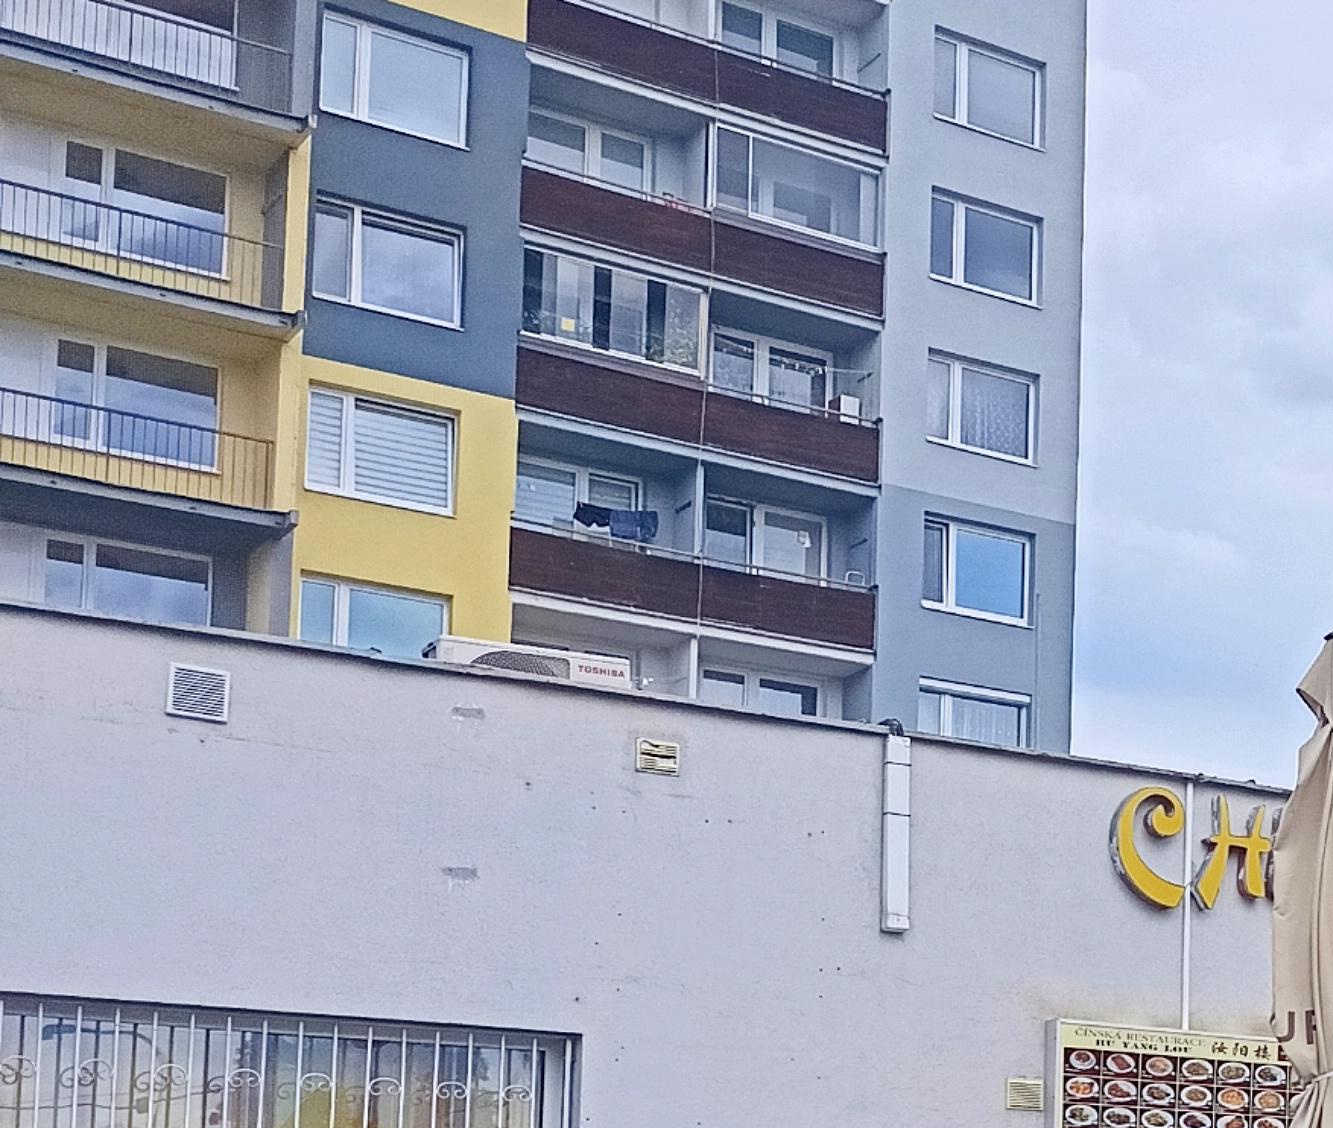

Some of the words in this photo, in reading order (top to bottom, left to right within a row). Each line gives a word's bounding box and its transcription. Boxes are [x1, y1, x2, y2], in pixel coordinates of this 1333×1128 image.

[578, 664, 625, 678] TOSHIBA
[1122, 1041, 1159, 1051] YANG
[1126, 1032, 1206, 1048] RESTAURACE
